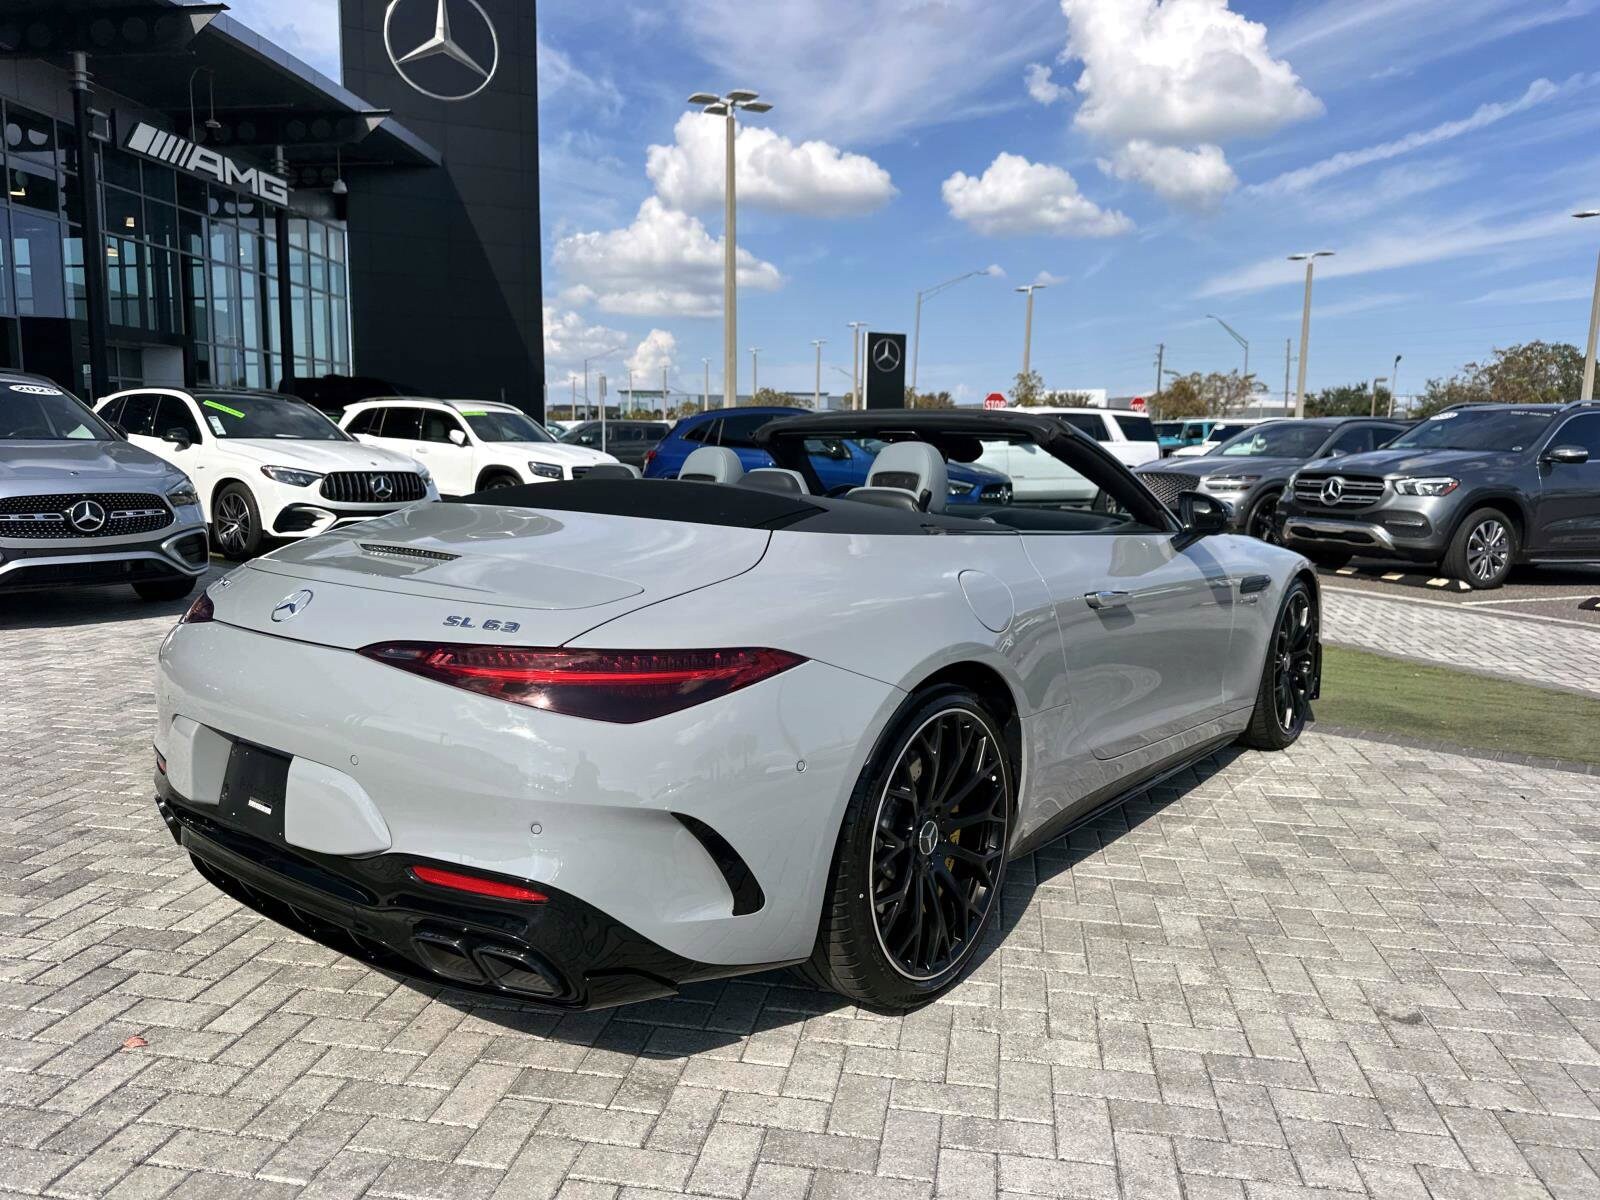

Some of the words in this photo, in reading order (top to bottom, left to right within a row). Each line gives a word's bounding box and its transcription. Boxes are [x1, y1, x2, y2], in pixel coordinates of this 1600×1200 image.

[186, 145, 288, 206] AMG
[985, 399, 1006, 410] STOP
[442, 615, 476, 628] SL
[482, 619, 520, 633] 63
